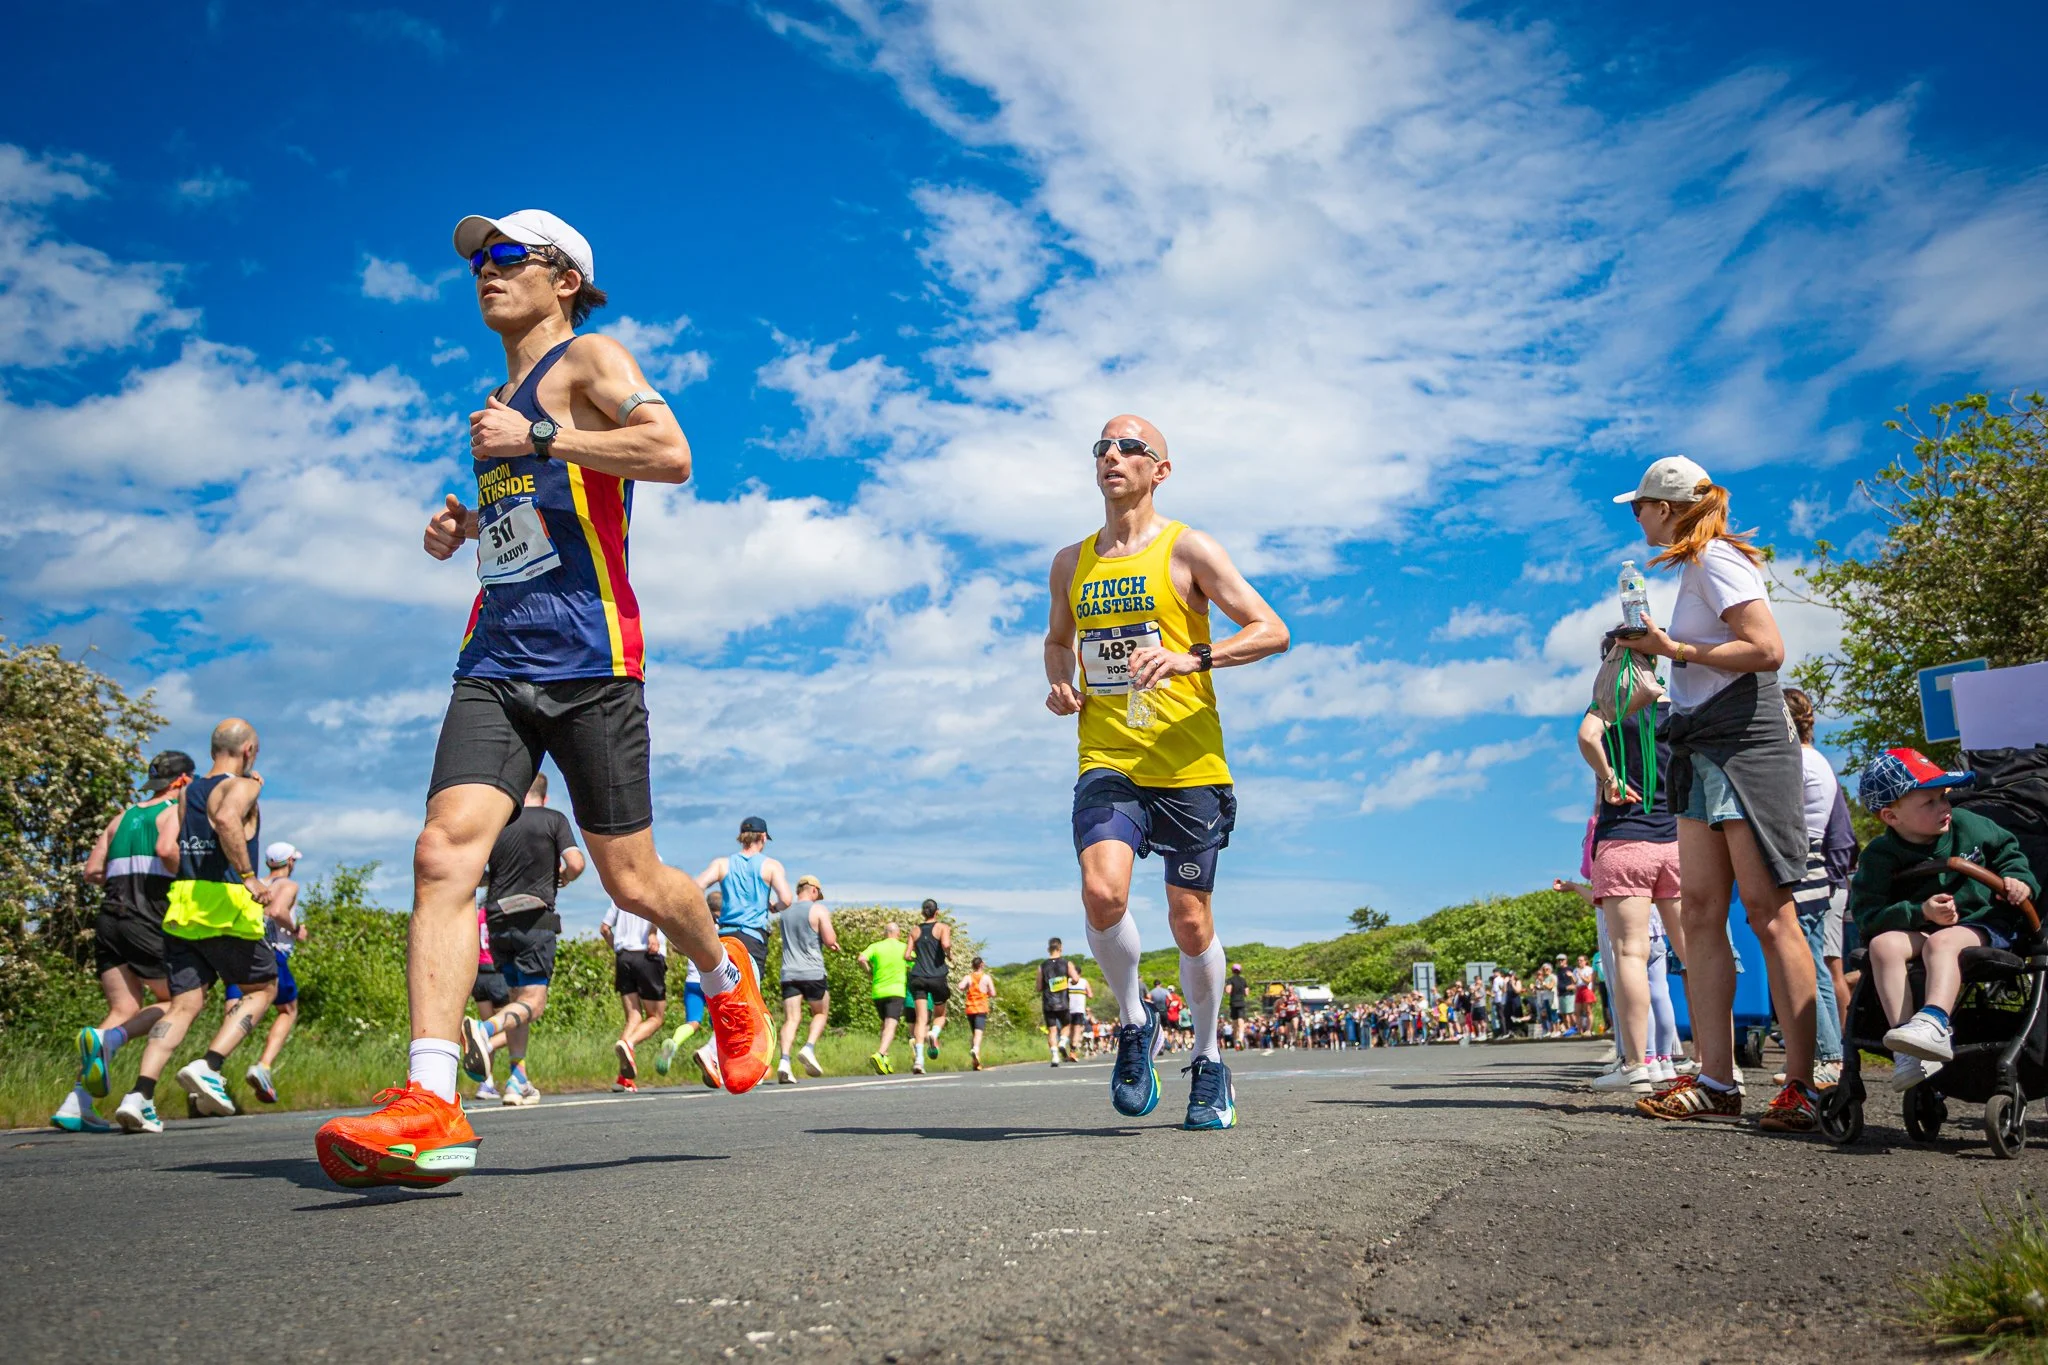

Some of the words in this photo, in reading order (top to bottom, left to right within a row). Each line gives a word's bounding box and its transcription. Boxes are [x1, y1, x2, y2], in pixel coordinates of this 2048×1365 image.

[479, 463, 511, 489] ONDON
[478, 474, 536, 507] ATHSIDE
[488, 516, 516, 549] 317
[496, 541, 529, 566] KAZUYA
[1081, 576, 1146, 601] FINCH
[1076, 596, 1155, 619] COASTERS
[1098, 640, 1138, 661] 483
[1106, 664, 1131, 675] ROS
